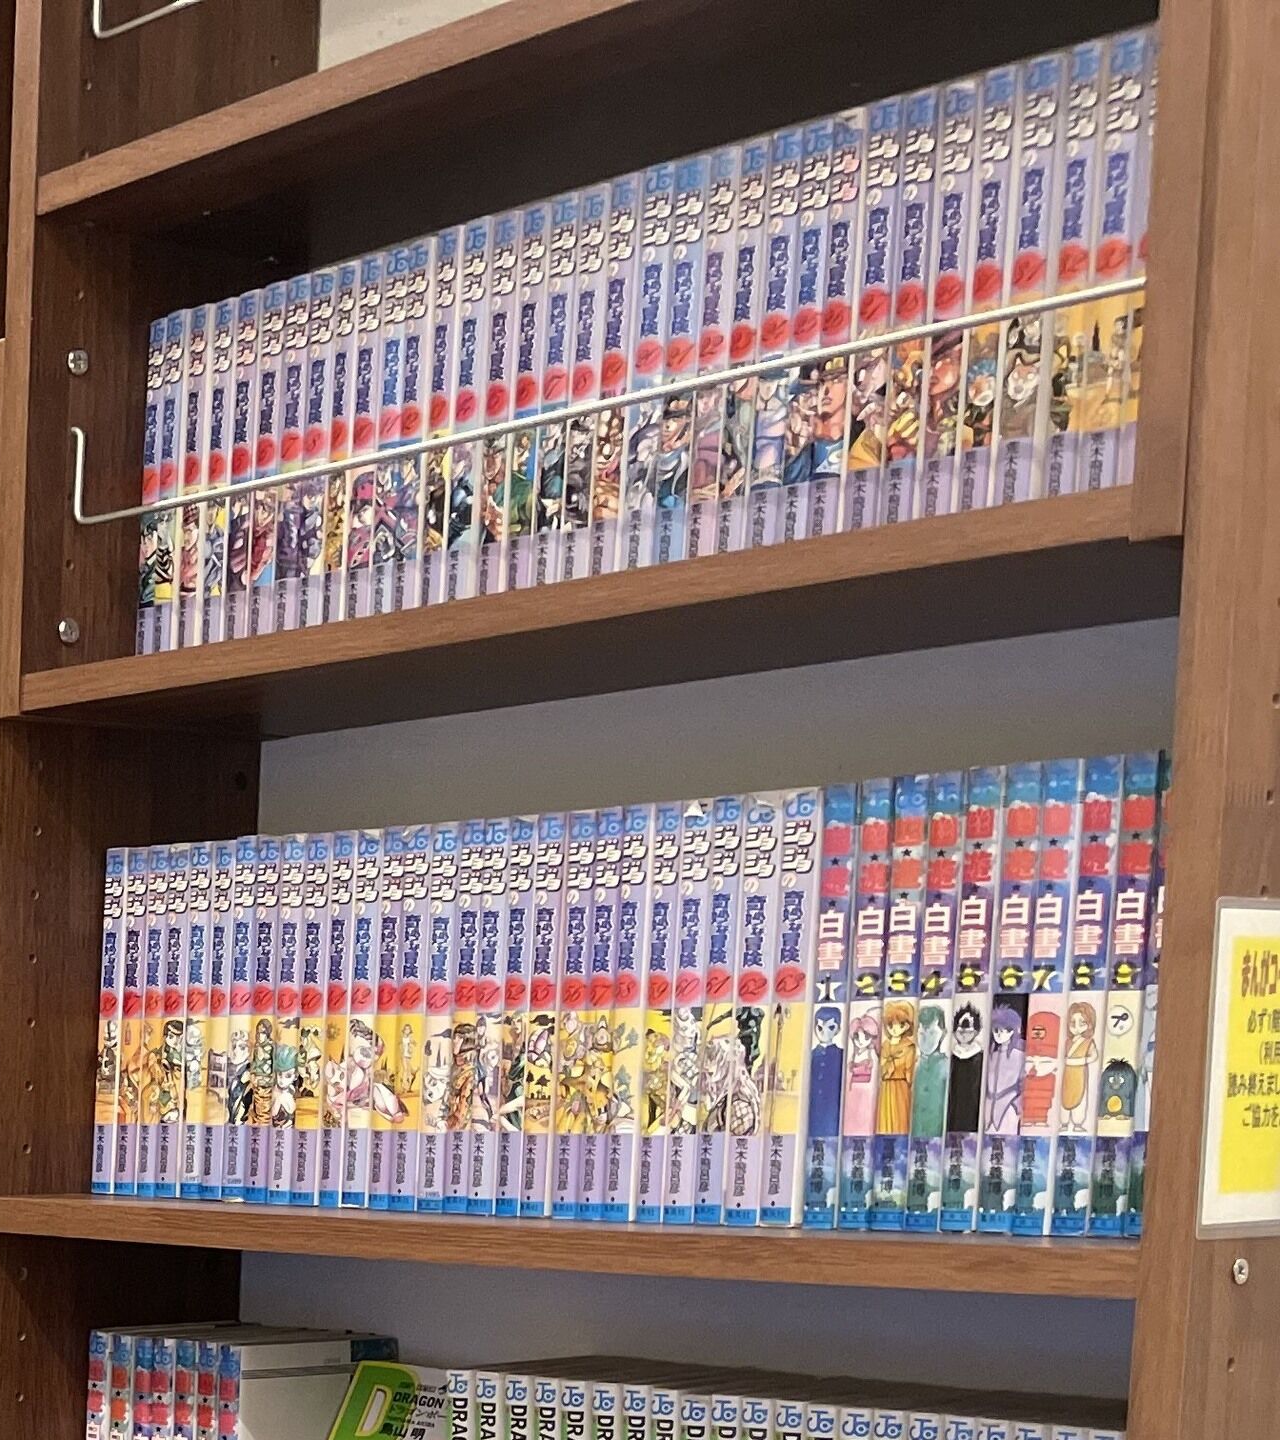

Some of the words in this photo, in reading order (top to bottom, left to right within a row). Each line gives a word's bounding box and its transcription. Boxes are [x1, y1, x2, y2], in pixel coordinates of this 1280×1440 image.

[1242, 950, 1280, 997] まんがコ
[1242, 1103, 1280, 1128] ご協力を
